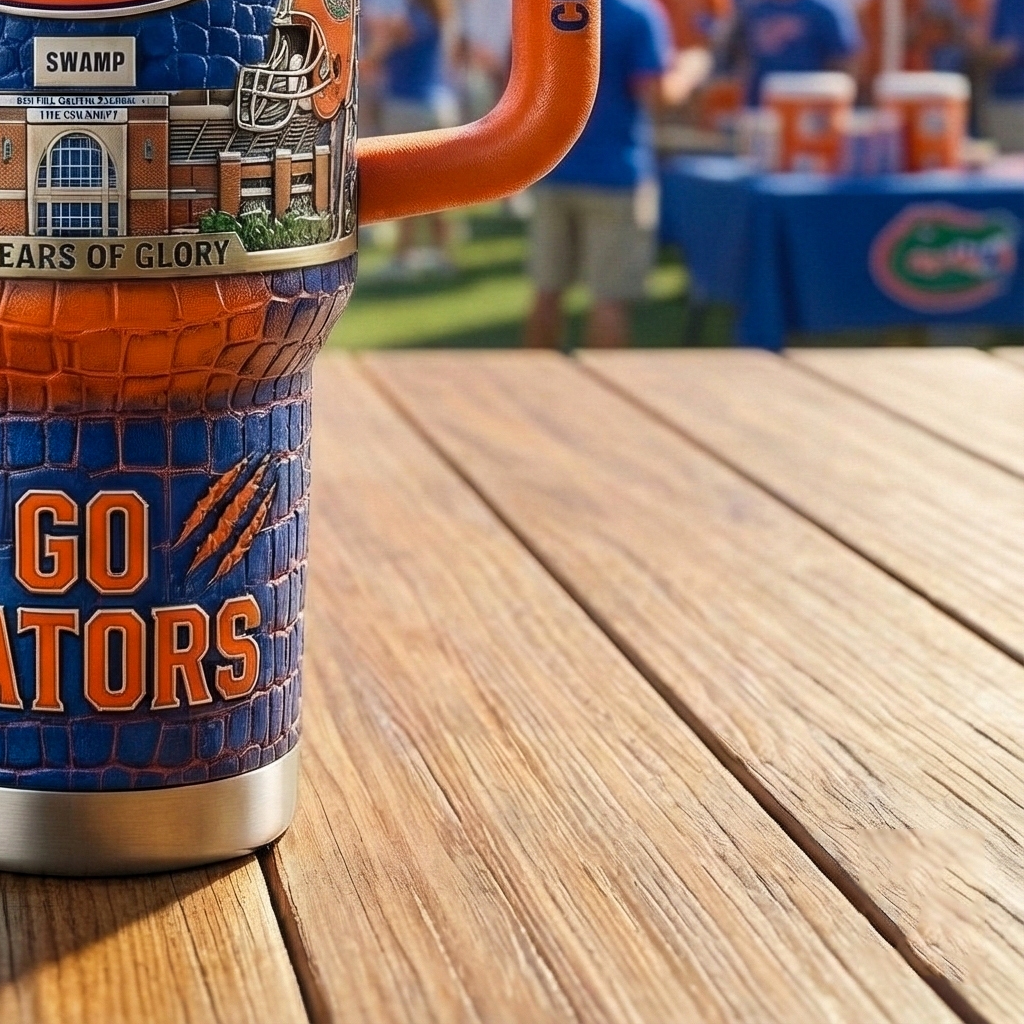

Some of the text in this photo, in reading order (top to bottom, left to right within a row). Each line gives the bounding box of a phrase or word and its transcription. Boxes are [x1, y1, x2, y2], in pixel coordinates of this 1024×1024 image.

[46, 50, 125, 73] SWAMP
[87, 243, 126, 270] OF
[135, 239, 230, 269] GLORY
[14, 488, 149, 595] GO
